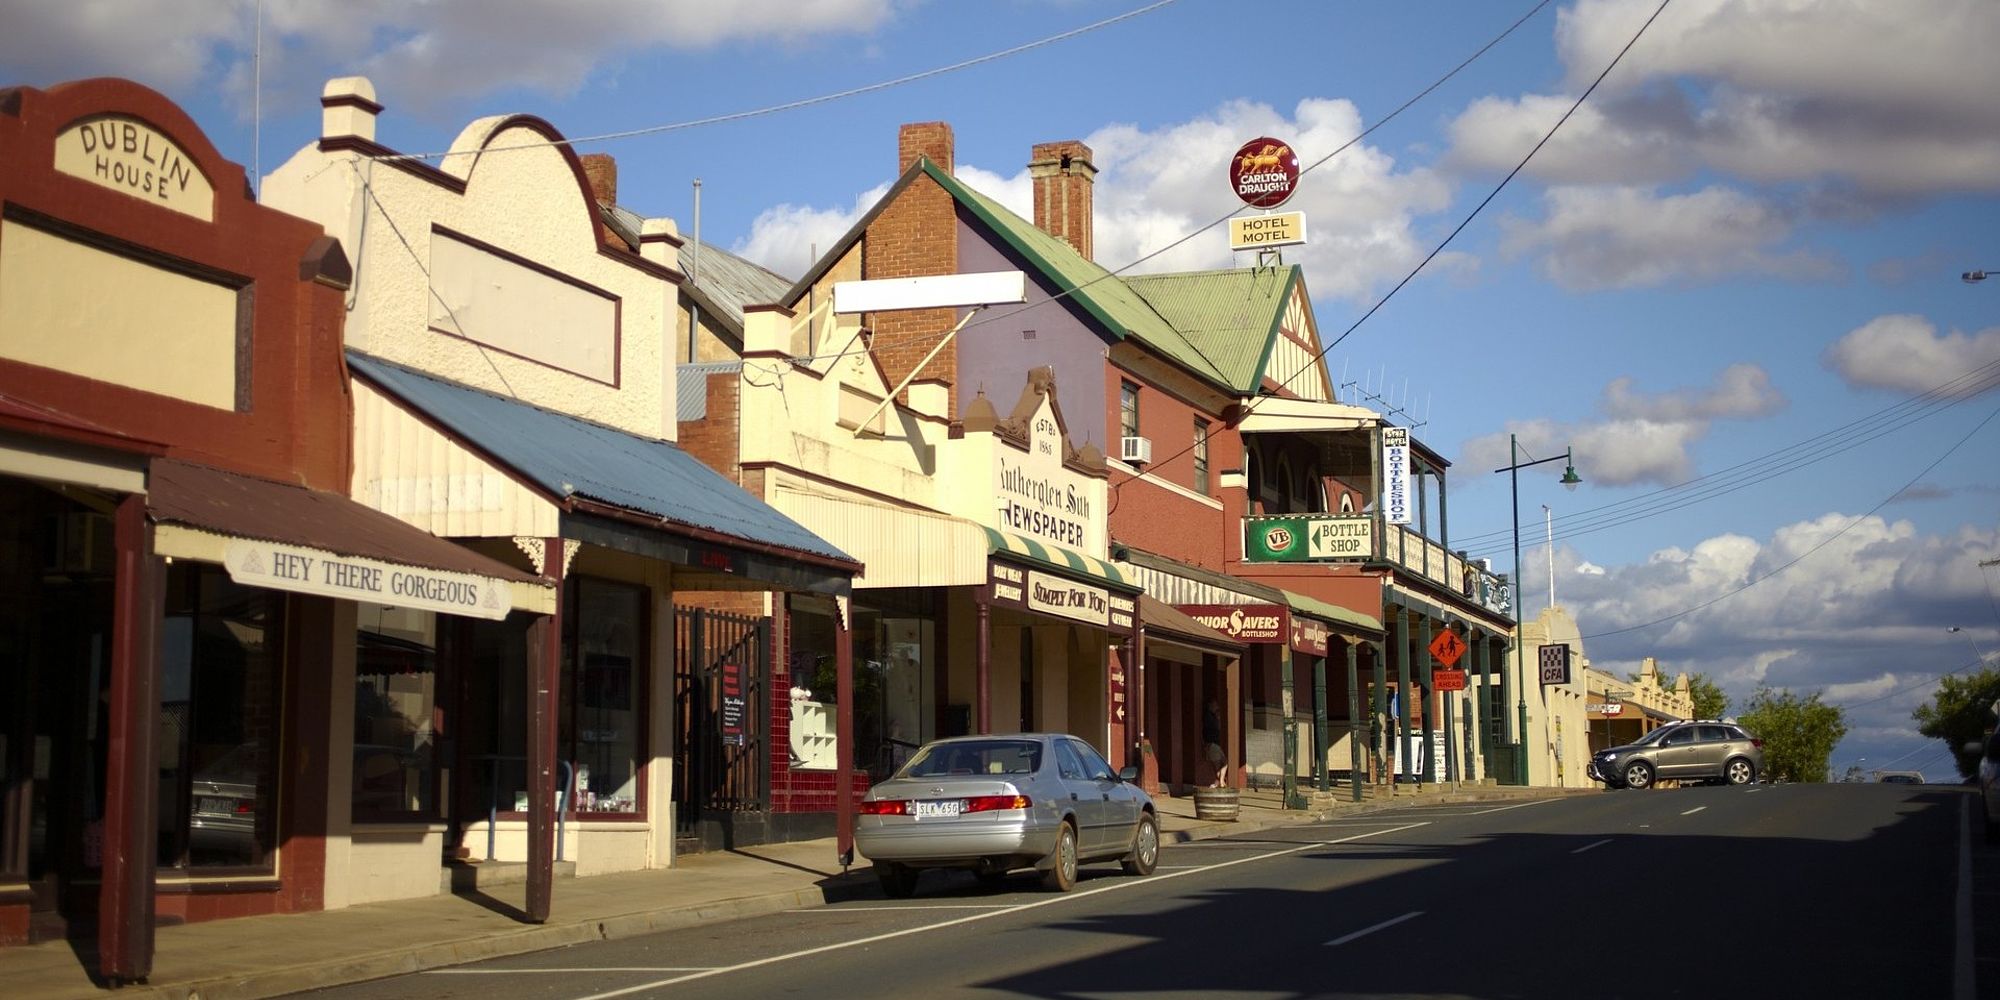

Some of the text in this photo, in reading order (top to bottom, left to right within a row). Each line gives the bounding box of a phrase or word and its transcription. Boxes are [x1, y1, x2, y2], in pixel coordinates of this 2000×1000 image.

[80, 121, 191, 192] DUBLIN
[96, 155, 169, 199] HOUSE
[1240, 172, 1287, 185] CARLTON
[1239, 182, 1291, 195] DRAUGHT
[1243, 218, 1289, 231] HOTEL
[1243, 231, 1290, 243] MOTEL
[1389, 448, 1406, 521] BOTTLESHOP
[1003, 500, 1083, 548] NEWSPAPER
[1322, 523, 1369, 537] BOTTLE
[1268, 530, 1290, 545] VB
[1330, 539, 1360, 553] SHOP
[273, 551, 478, 606] HEY THERE GORGEOUS
[1034, 581, 1107, 615] SIMPLY FOR YOU
[1242, 630, 1278, 638] BOTTLESHOP
[1544, 668, 1562, 681] CFA
[920, 804, 936, 814] SLK
